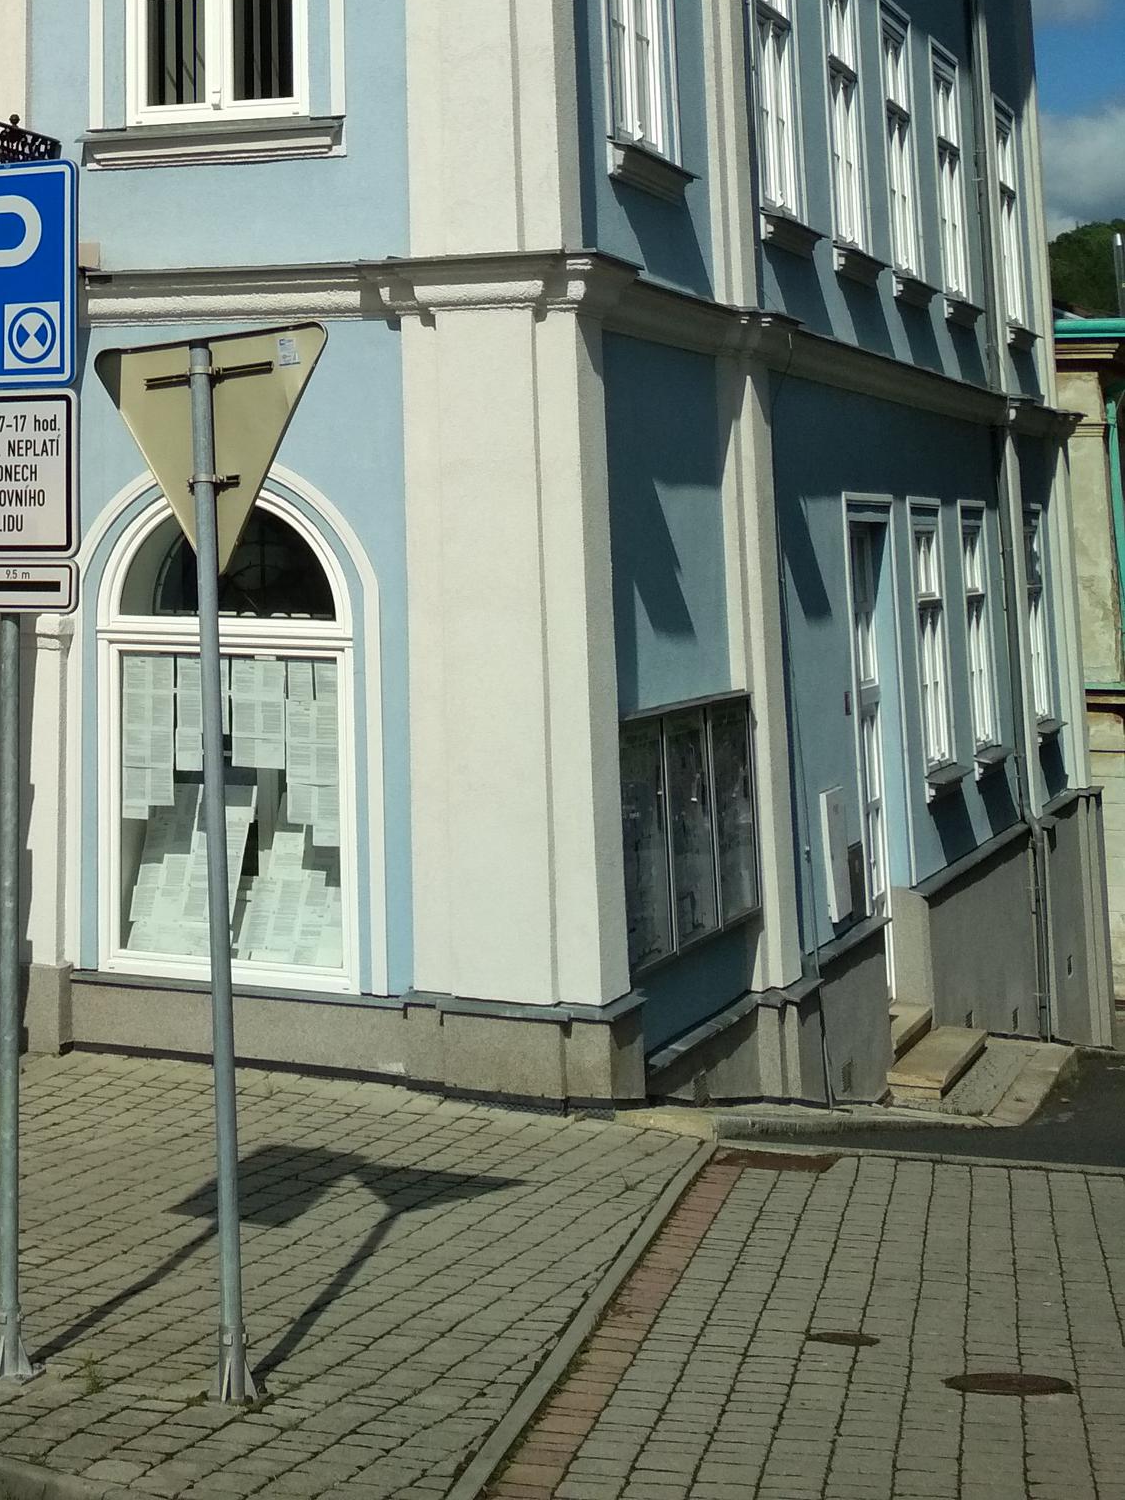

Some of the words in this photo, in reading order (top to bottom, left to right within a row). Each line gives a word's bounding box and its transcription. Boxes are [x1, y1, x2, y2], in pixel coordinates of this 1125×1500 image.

[33, 413, 61, 432] hod.
[7, 434, 61, 457] NEPLATÍ
[21, 571, 31, 579] m
